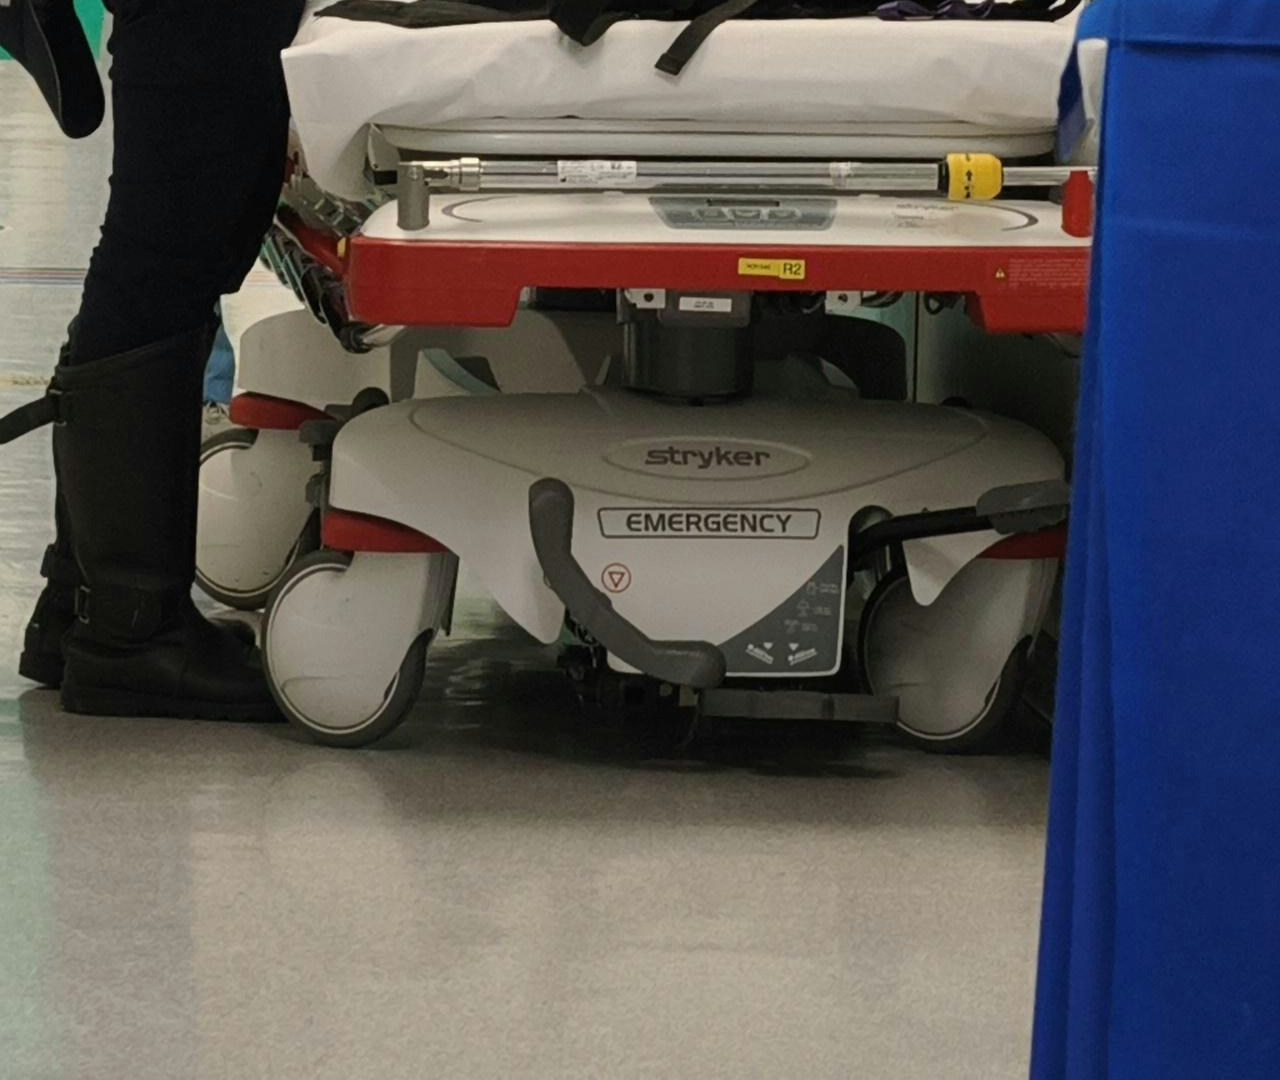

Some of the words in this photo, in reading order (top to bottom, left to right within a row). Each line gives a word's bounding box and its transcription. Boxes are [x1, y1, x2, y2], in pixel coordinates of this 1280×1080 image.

[783, 262, 802, 276] R2
[644, 445, 770, 469] stryker
[625, 512, 792, 533] EMERGENCY
